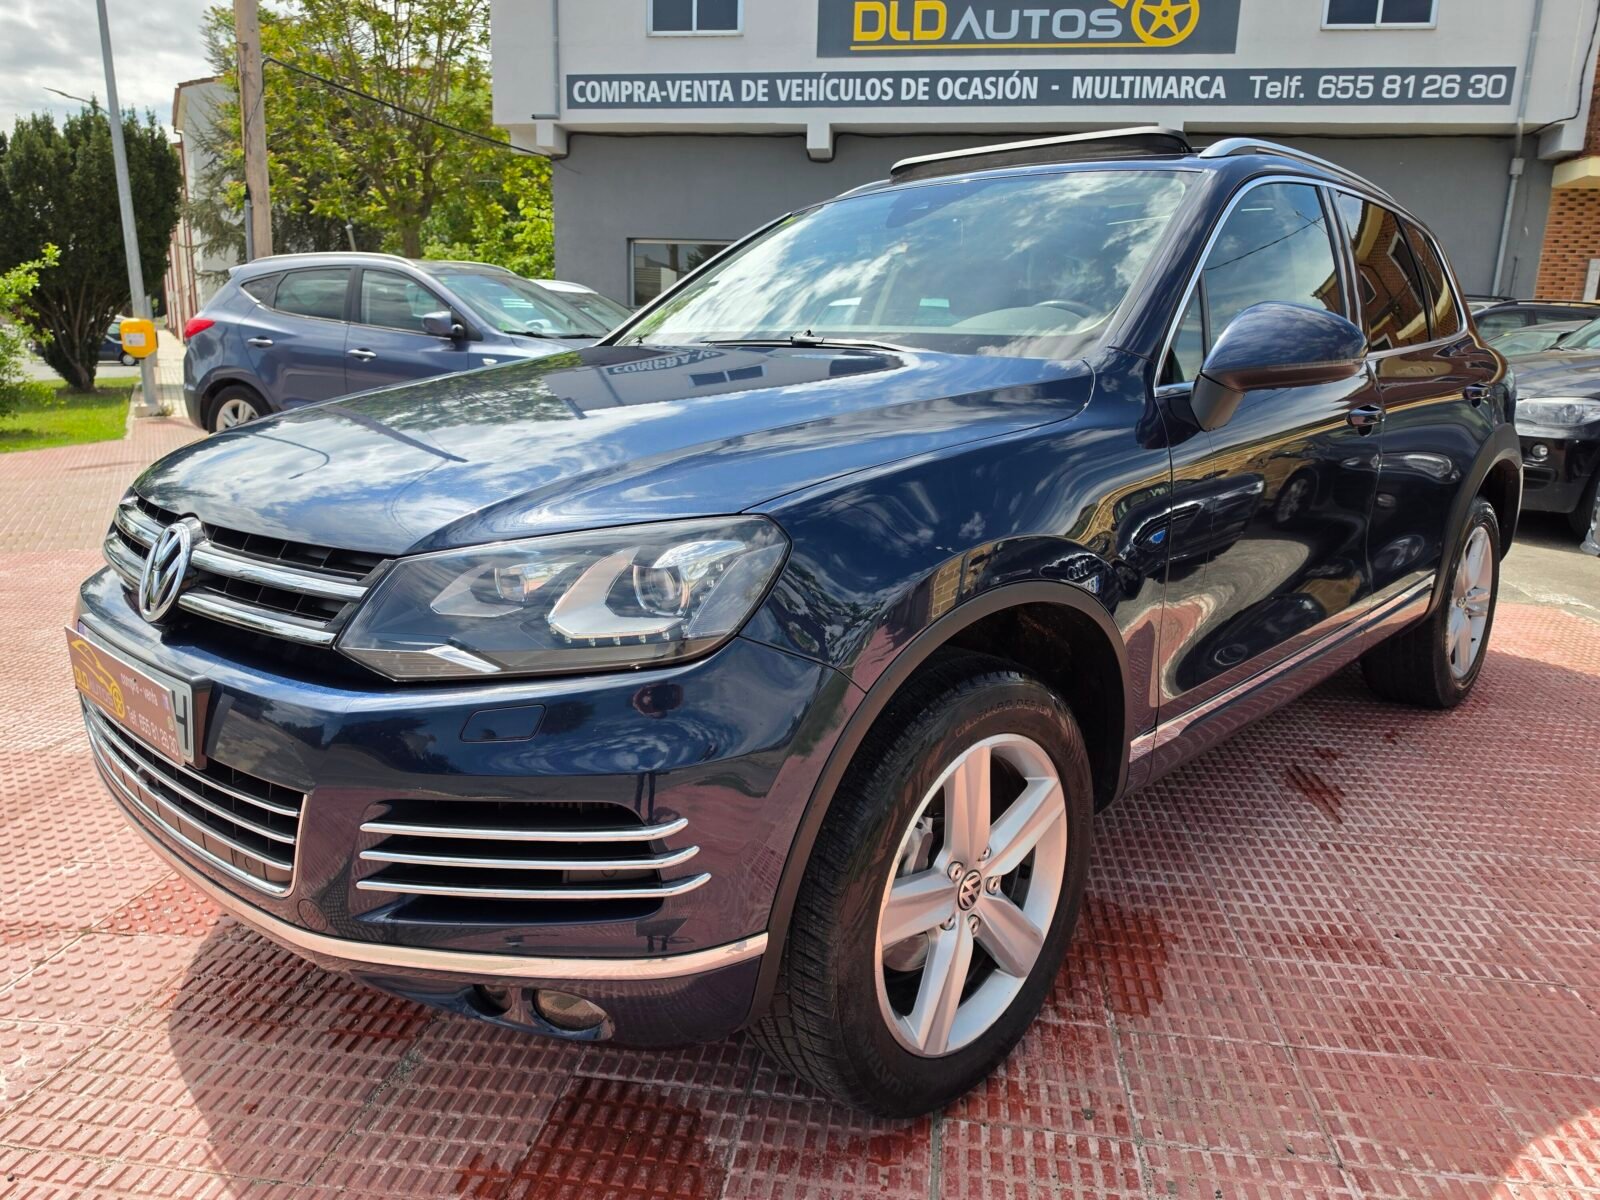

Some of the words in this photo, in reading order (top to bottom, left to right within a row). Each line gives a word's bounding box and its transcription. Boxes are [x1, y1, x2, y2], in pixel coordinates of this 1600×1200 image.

[854, 1, 947, 42] DLD
[951, 5, 1123, 40] AUTOS
[572, 79, 734, 103] COMPRA-VENTA
[742, 79, 768, 102] DE
[776, 73, 893, 102] VEHÍCULOS
[901, 78, 929, 101] DE
[937, 70, 1038, 101] OCASIÓN
[1072, 76, 1226, 99] MULTIMARCA
[1249, 75, 1304, 99] Telf.
[1318, 75, 1375, 99] 655
[1467, 74, 1507, 98] 30
